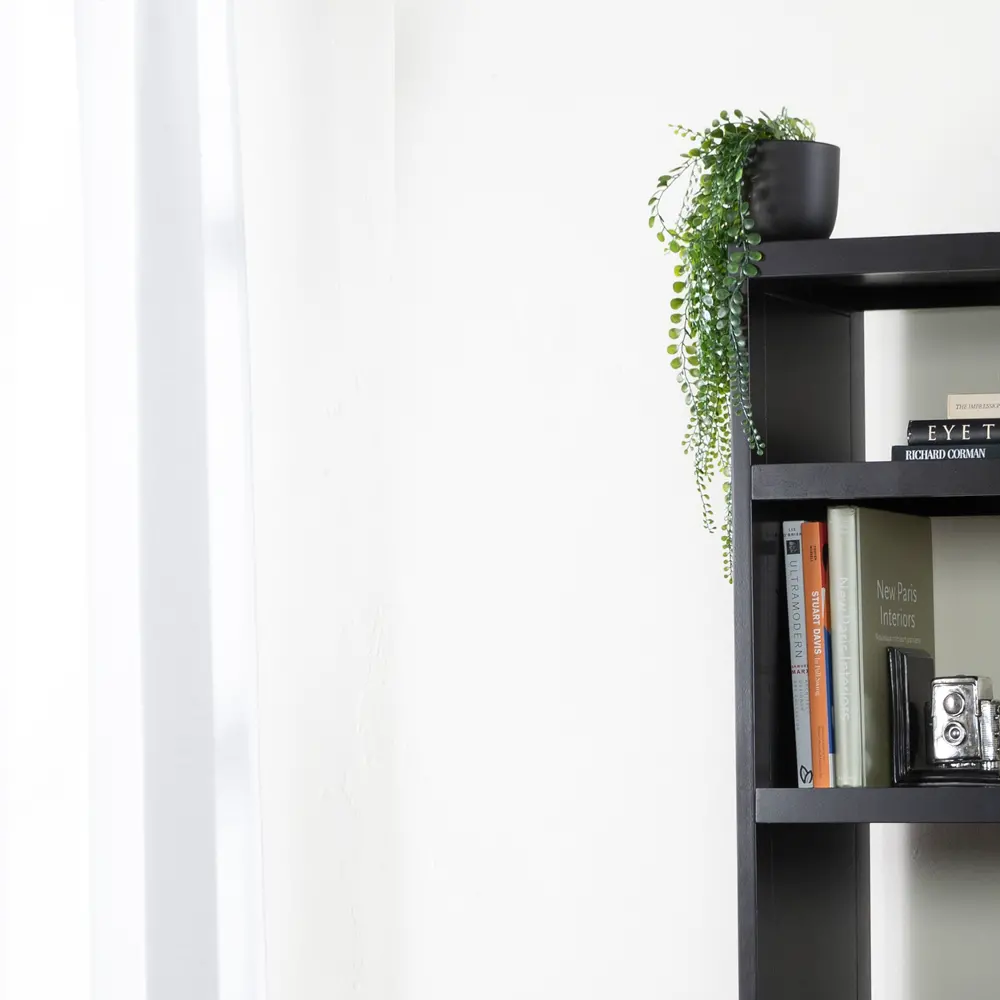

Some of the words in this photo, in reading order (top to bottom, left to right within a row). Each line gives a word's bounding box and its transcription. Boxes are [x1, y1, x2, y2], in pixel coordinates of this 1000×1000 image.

[928, 424, 971, 441] EYE
[905, 448, 946, 460] RICHARD
[947, 447, 986, 460] CORMAN
[839, 577, 849, 611] New
[876, 580, 896, 600] New
[897, 581, 918, 603] Paris
[789, 560, 803, 659] ULTRAMODERN
[811, 590, 820, 626] STUART
[879, 605, 916, 628] Interiors
[812, 628, 821, 655] DAVIS
